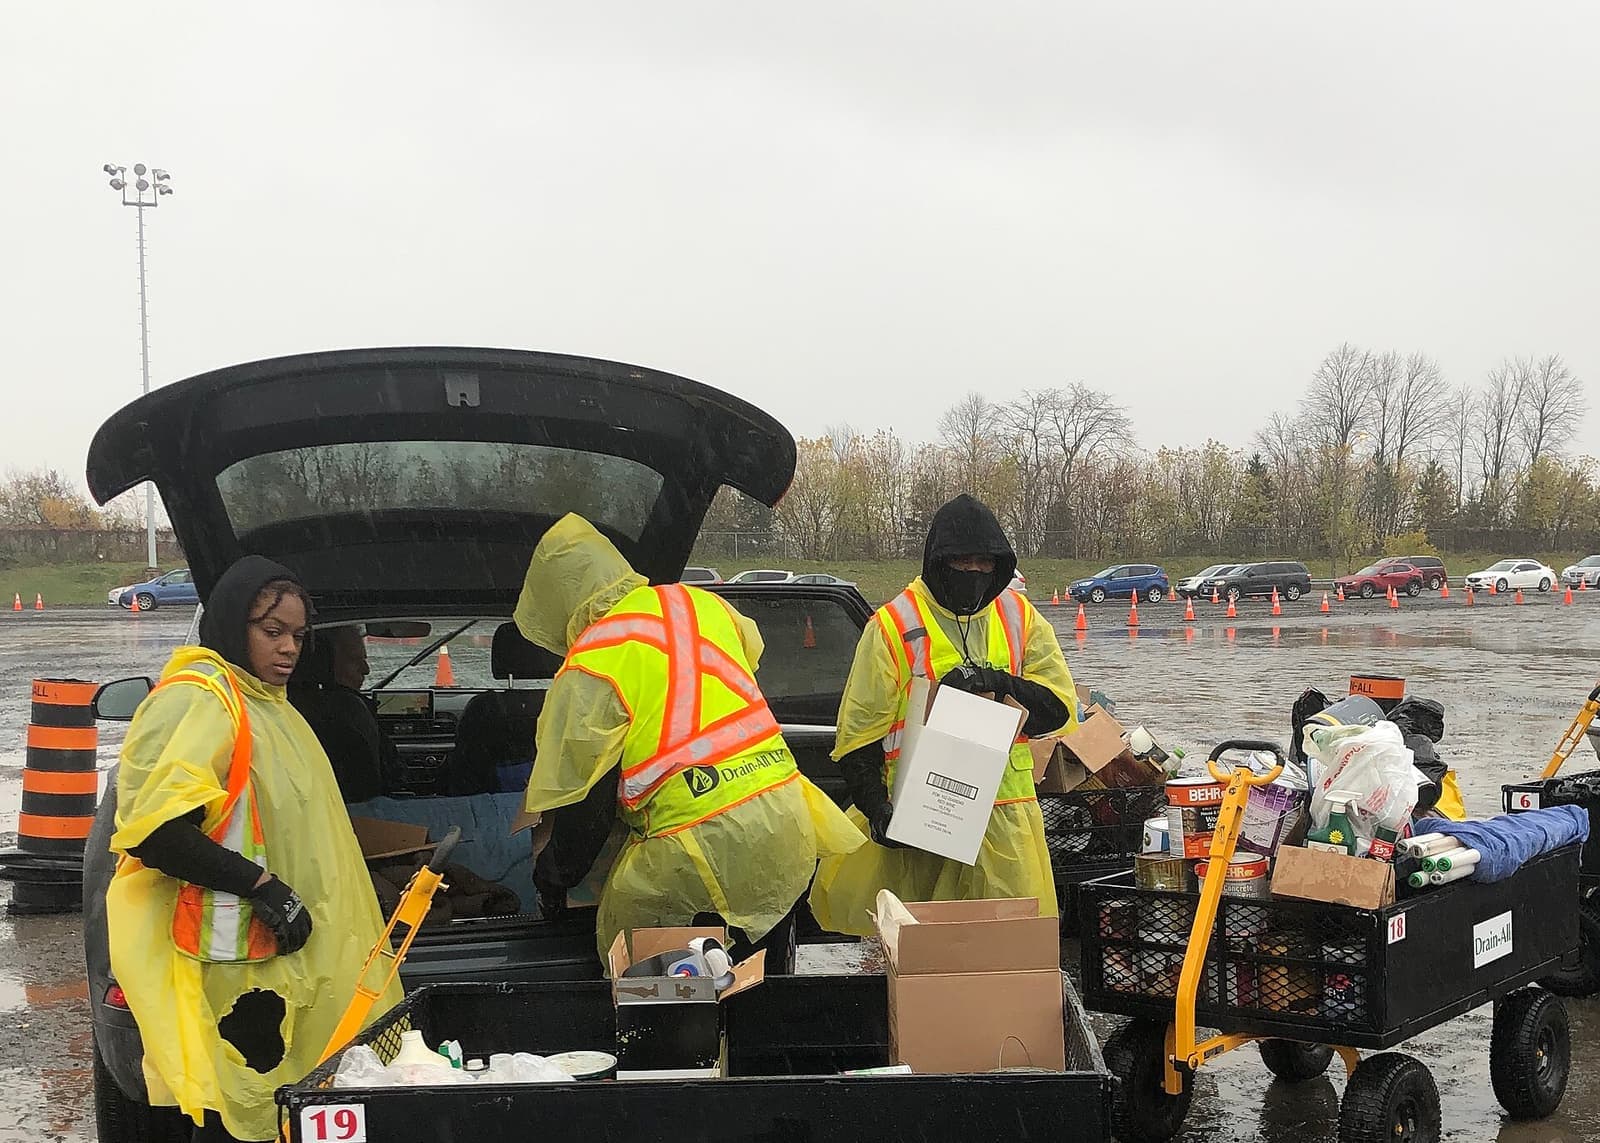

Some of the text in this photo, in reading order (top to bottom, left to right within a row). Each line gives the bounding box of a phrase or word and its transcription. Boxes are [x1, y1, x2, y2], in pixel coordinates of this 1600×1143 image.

[721, 753, 771, 783] Drain-All
[1189, 787, 1221, 802] BEHR
[1520, 794, 1531, 808] 6
[1205, 815, 1217, 823] Wo
[1226, 867, 1245, 878] EHR
[1223, 883, 1252, 893] Concrete
[1390, 917, 1404, 940] 18
[1475, 922, 1511, 956] Drain-All
[309, 1109, 358, 1141] 19
